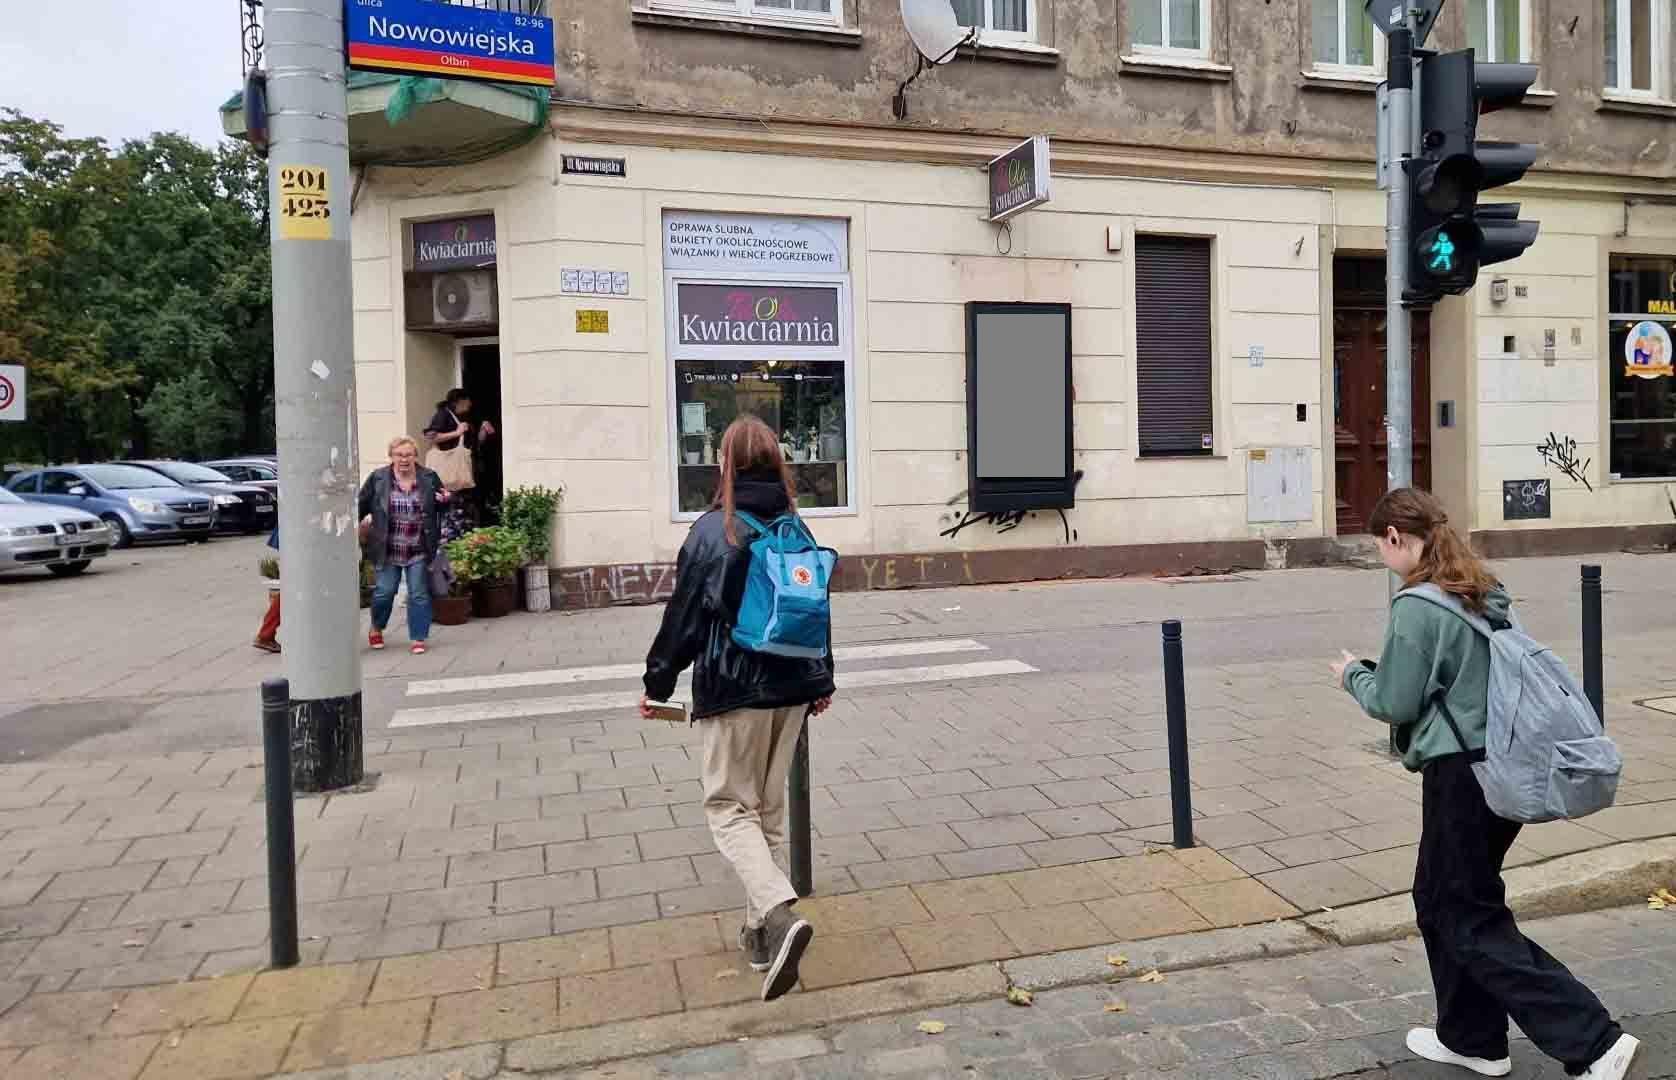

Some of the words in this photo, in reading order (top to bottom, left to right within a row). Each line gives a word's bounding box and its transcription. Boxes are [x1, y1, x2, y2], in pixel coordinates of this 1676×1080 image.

[514, 16, 545, 29] 82-96
[369, 15, 535, 56] Nowowiejska
[281, 169, 327, 191] 201
[670, 222, 713, 233] OPRAWA
[419, 237, 496, 261] Kwiaciarnia
[670, 235, 713, 245] BUKIETY
[716, 236, 809, 249] OKOLICZNOŚCIOWE
[670, 247, 720, 258] WIĄZANKI
[769, 251, 834, 263] POGRZEBOWE
[681, 313, 834, 342] Kwiaciarnia
